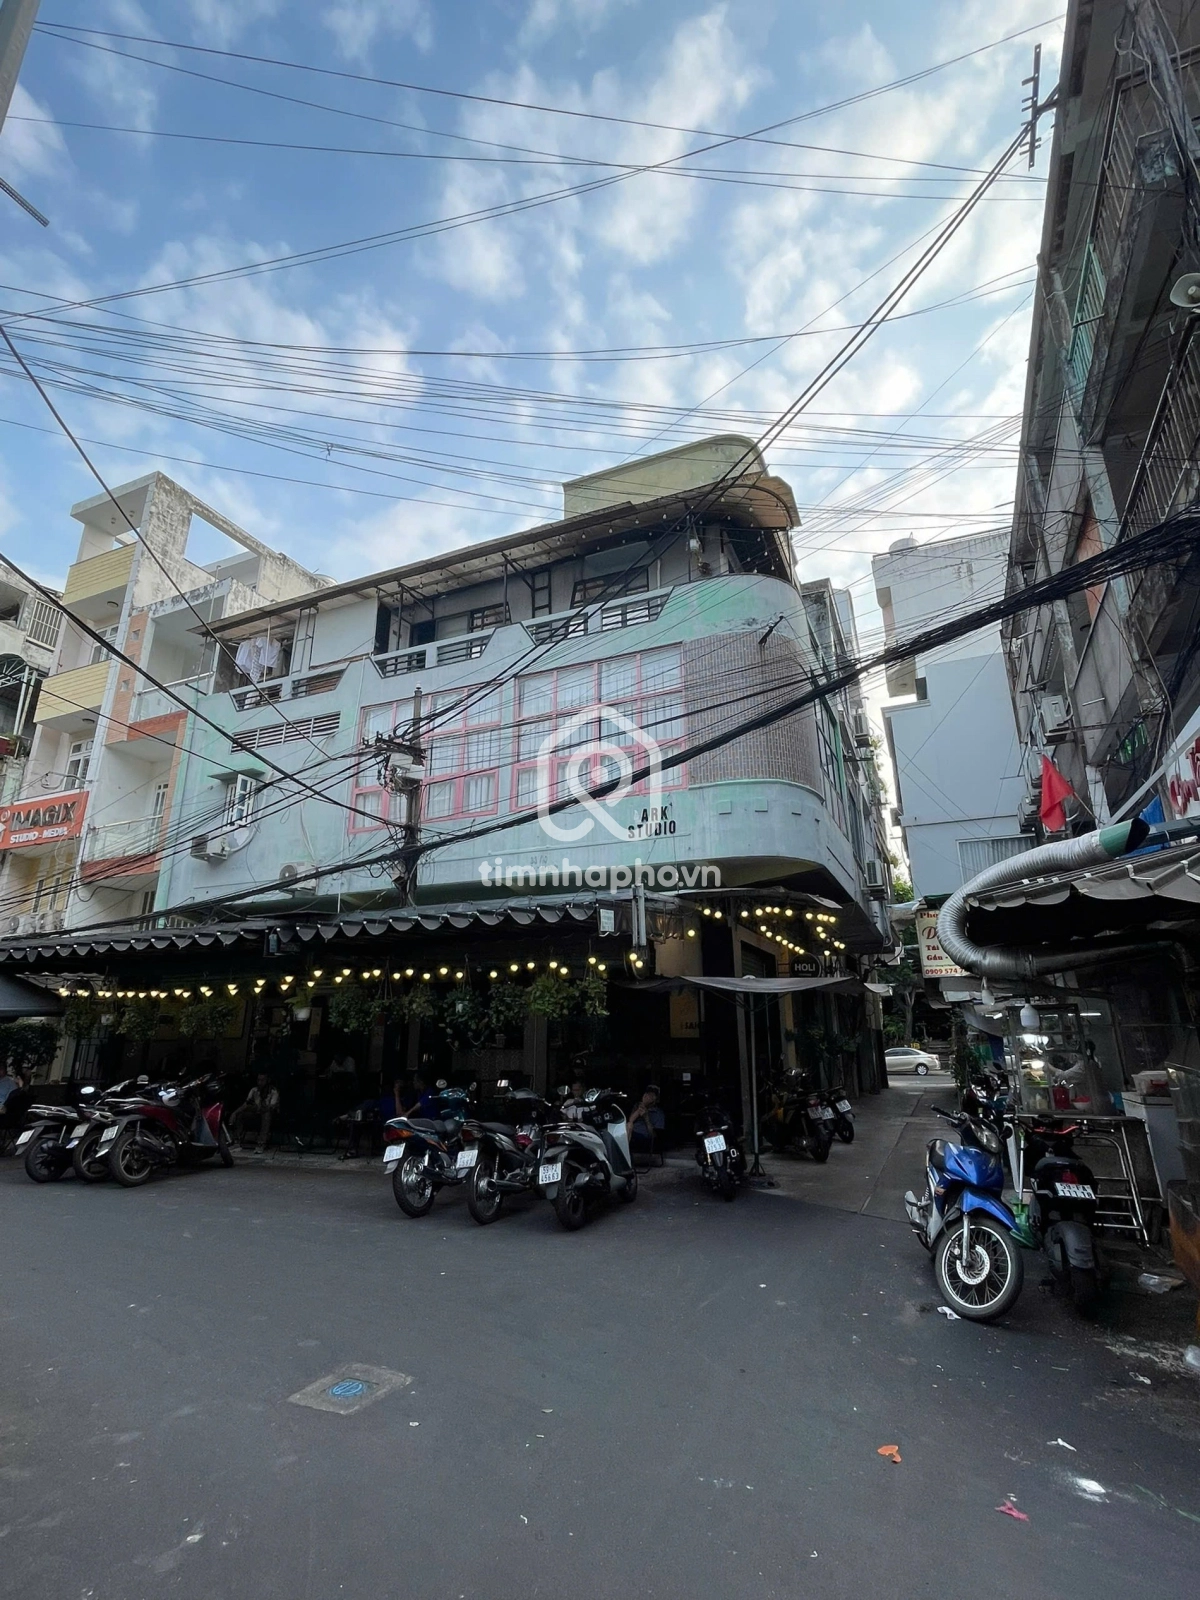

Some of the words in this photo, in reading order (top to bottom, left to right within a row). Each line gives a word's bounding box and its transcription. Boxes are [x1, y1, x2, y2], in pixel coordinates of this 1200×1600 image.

[11, 801, 77, 831] IMAGIX
[641, 806, 668, 822] ARK
[10, 831, 38, 844] STUDIO
[628, 820, 676, 839] STUDIO
[794, 963, 816, 971] HOLI
